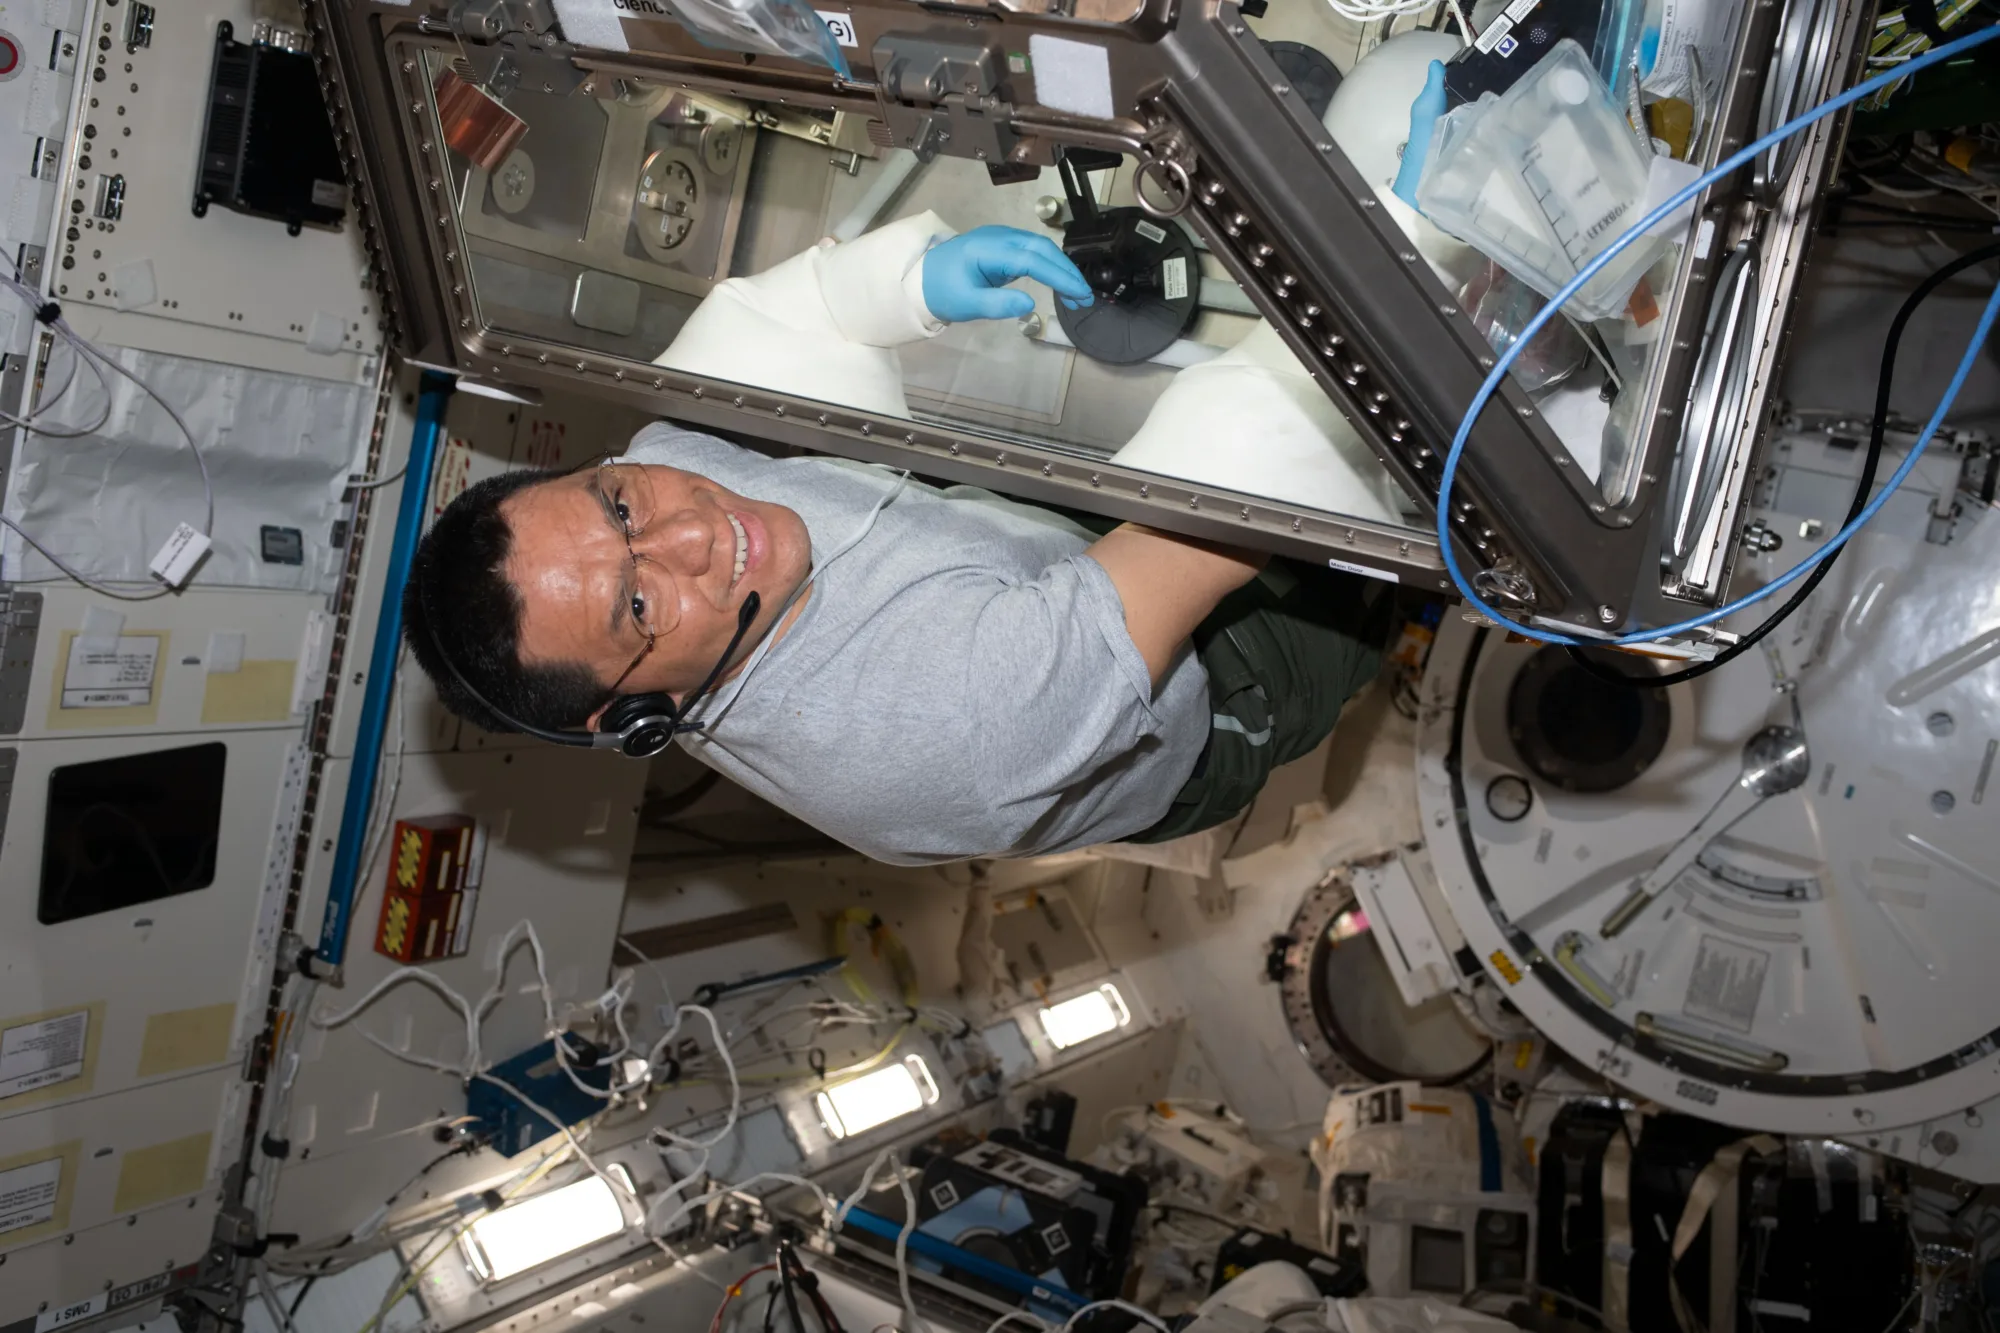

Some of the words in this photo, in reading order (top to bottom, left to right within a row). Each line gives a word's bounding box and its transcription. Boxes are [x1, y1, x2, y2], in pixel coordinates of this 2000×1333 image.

[1666, 4, 1674, 17] Kit
[1330, 561, 1347, 570] Main
[1347, 565, 1364, 573] Door
[64, 1301, 92, 1321] DMS
[54, 1312, 61, 1323] 1
